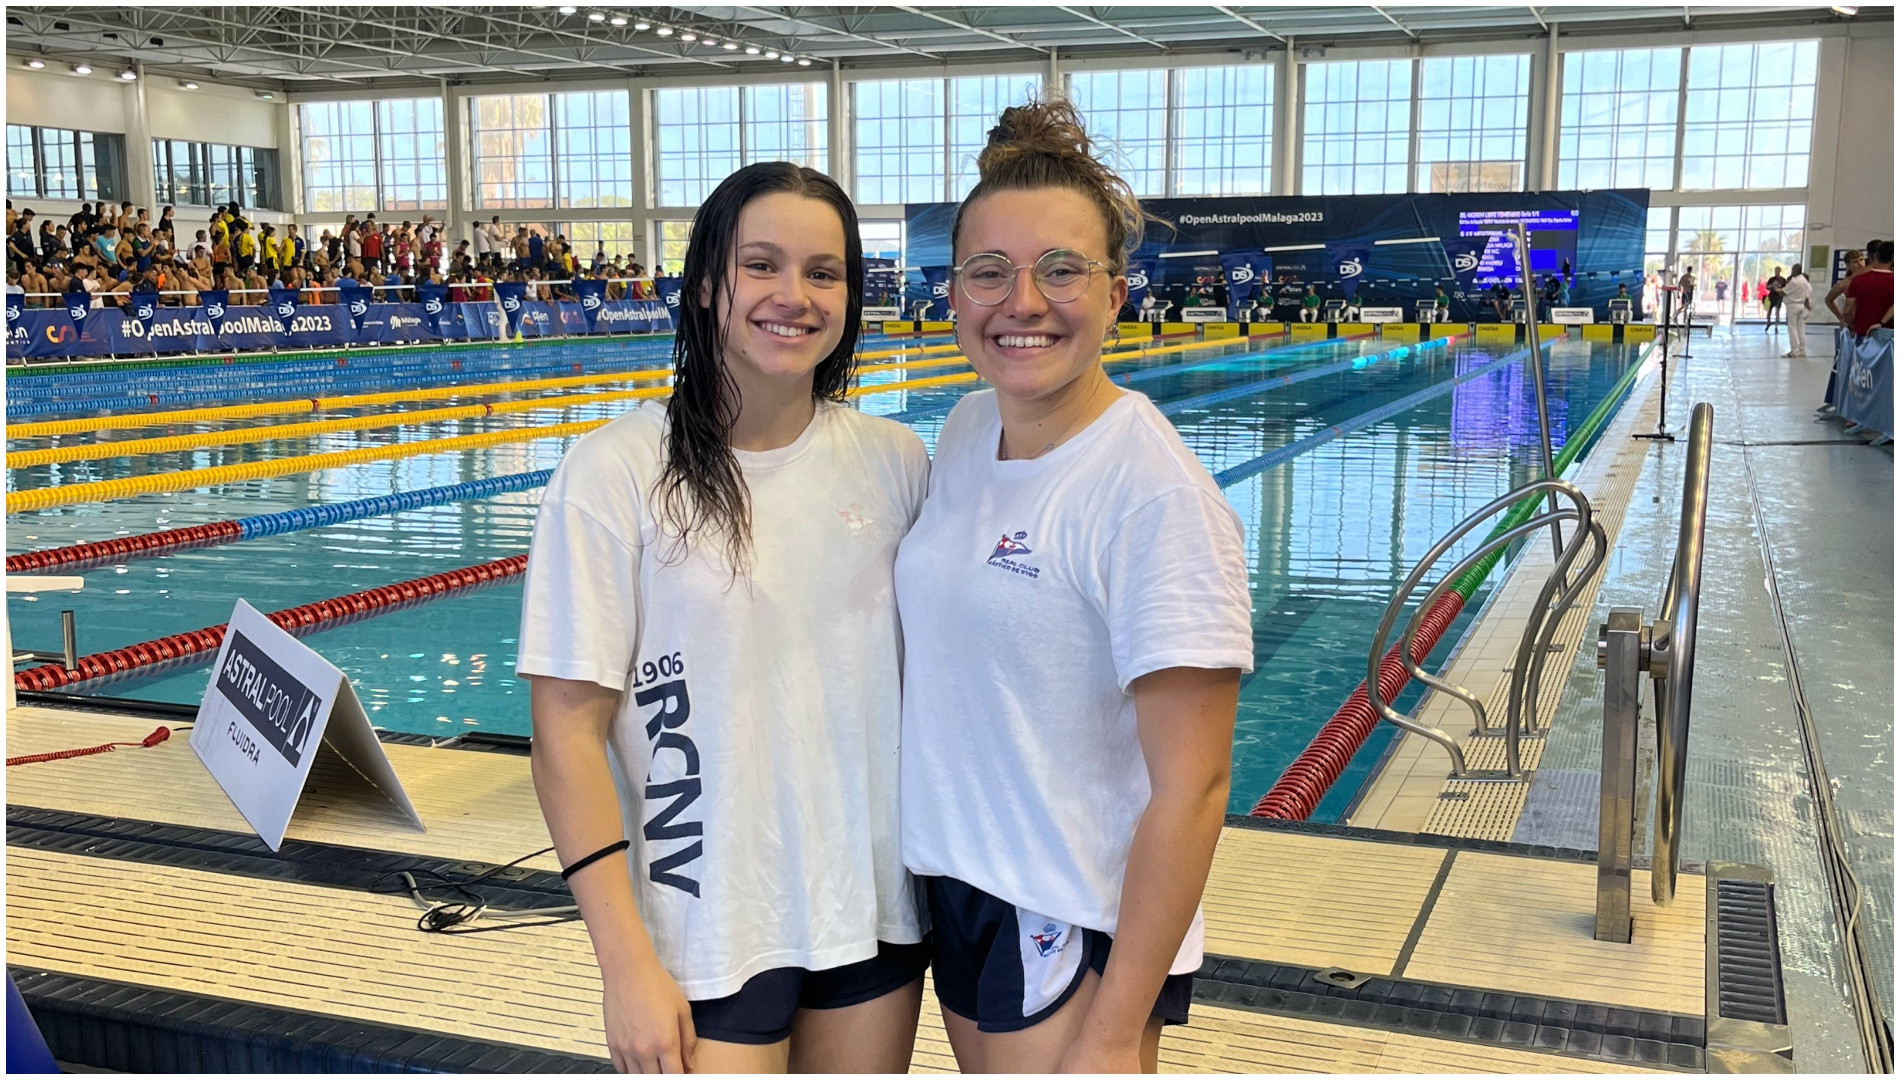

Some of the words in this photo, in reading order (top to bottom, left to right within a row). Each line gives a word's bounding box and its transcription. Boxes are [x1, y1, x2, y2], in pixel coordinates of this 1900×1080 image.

[1179, 212, 1325, 226] #OpenAstralpoolMalaga2023
[222, 648, 294, 734] ASTRALPOOL
[633, 651, 685, 688] 1906
[226, 721, 261, 767] FLUIDRA
[634, 679, 704, 899] RCNV
